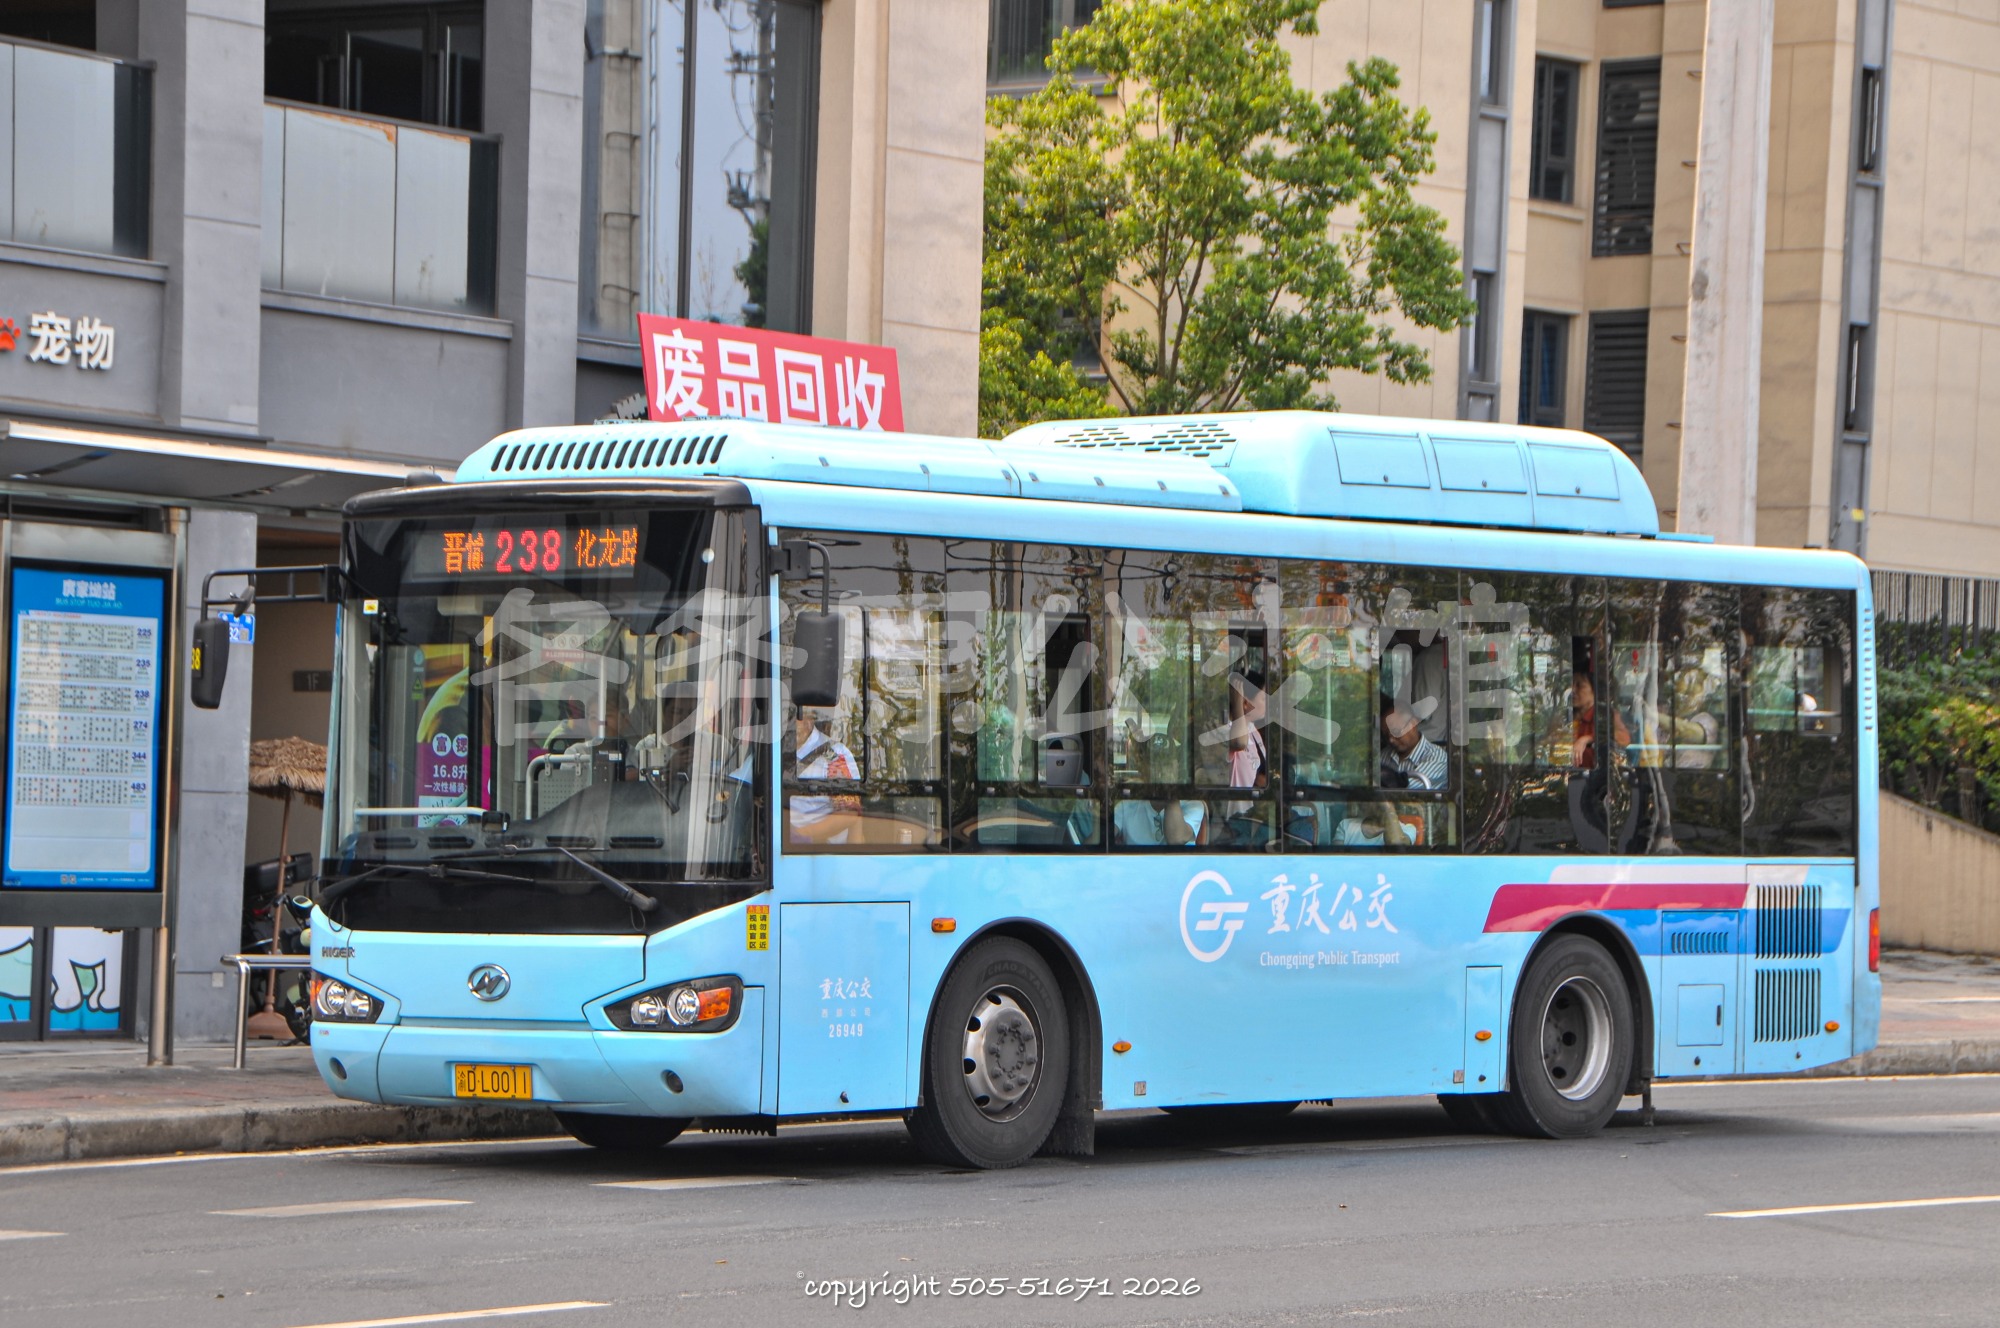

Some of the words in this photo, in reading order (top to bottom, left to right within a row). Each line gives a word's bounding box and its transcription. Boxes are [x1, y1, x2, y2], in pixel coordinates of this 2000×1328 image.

[30, 311, 115, 370] 宠物
[652, 328, 885, 431] 废品回收
[496, 529, 561, 573] 238
[137, 628, 151, 637] 225
[135, 690, 150, 698] 238
[133, 721, 148, 729] 274
[132, 752, 146, 760] 344
[424, 782, 468, 794] 一次性桶装
[1260, 873, 1399, 935] 重庆公交
[322, 946, 356, 958] HIGER
[1260, 951, 1315, 969] Chongqing
[1318, 950, 1348, 965] Public
[1351, 950, 1400, 968] Transport
[819, 977, 873, 999] 重庆公交
[829, 1023, 863, 1038] 26949
